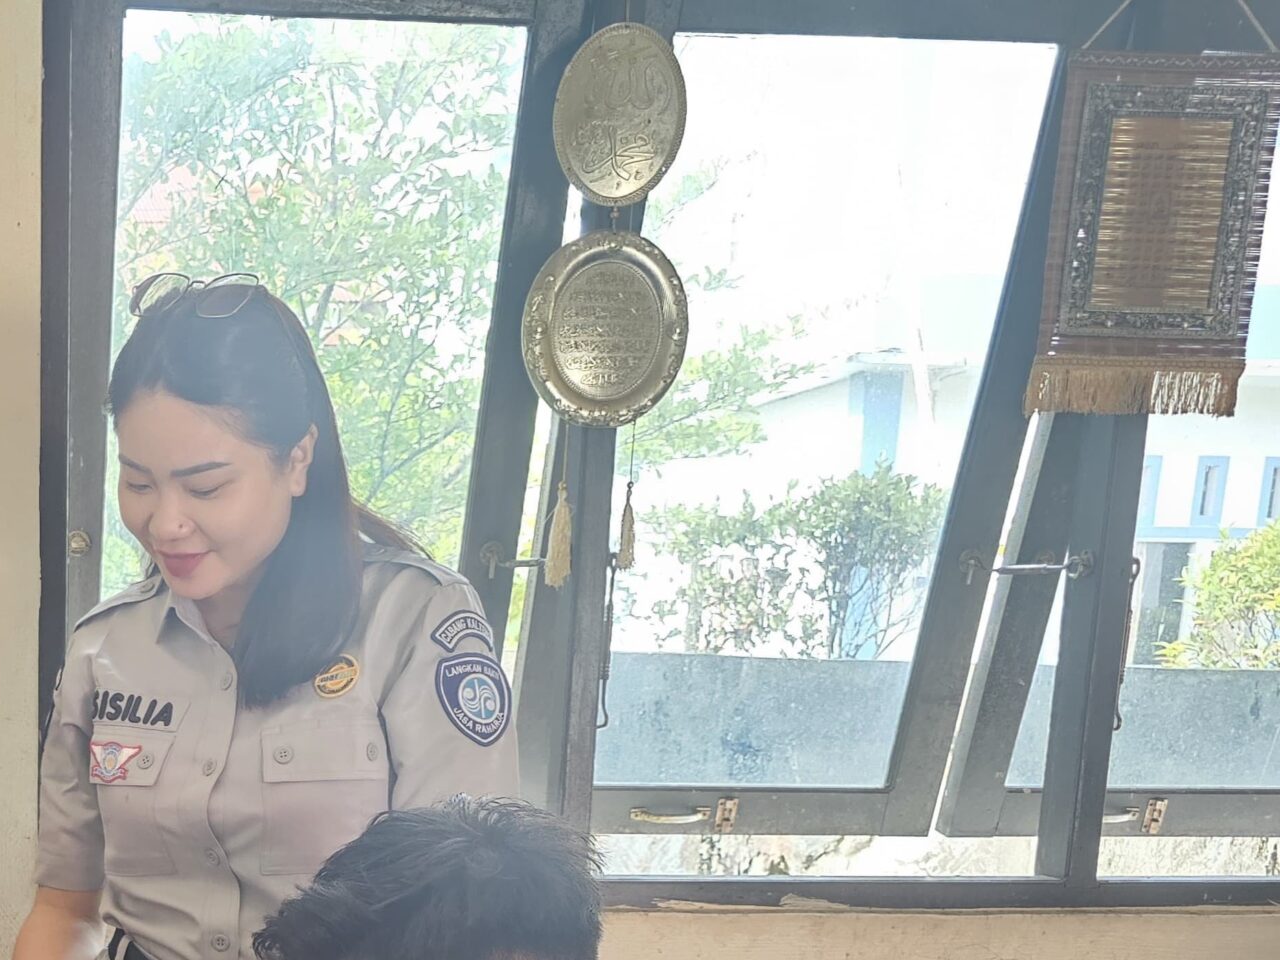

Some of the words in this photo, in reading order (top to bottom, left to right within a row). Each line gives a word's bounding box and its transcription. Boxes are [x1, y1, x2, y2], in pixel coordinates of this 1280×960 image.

[441, 618, 466, 642] CABANG
[453, 707, 473, 730] JASA
[475, 712, 505, 734] RAHARJA
